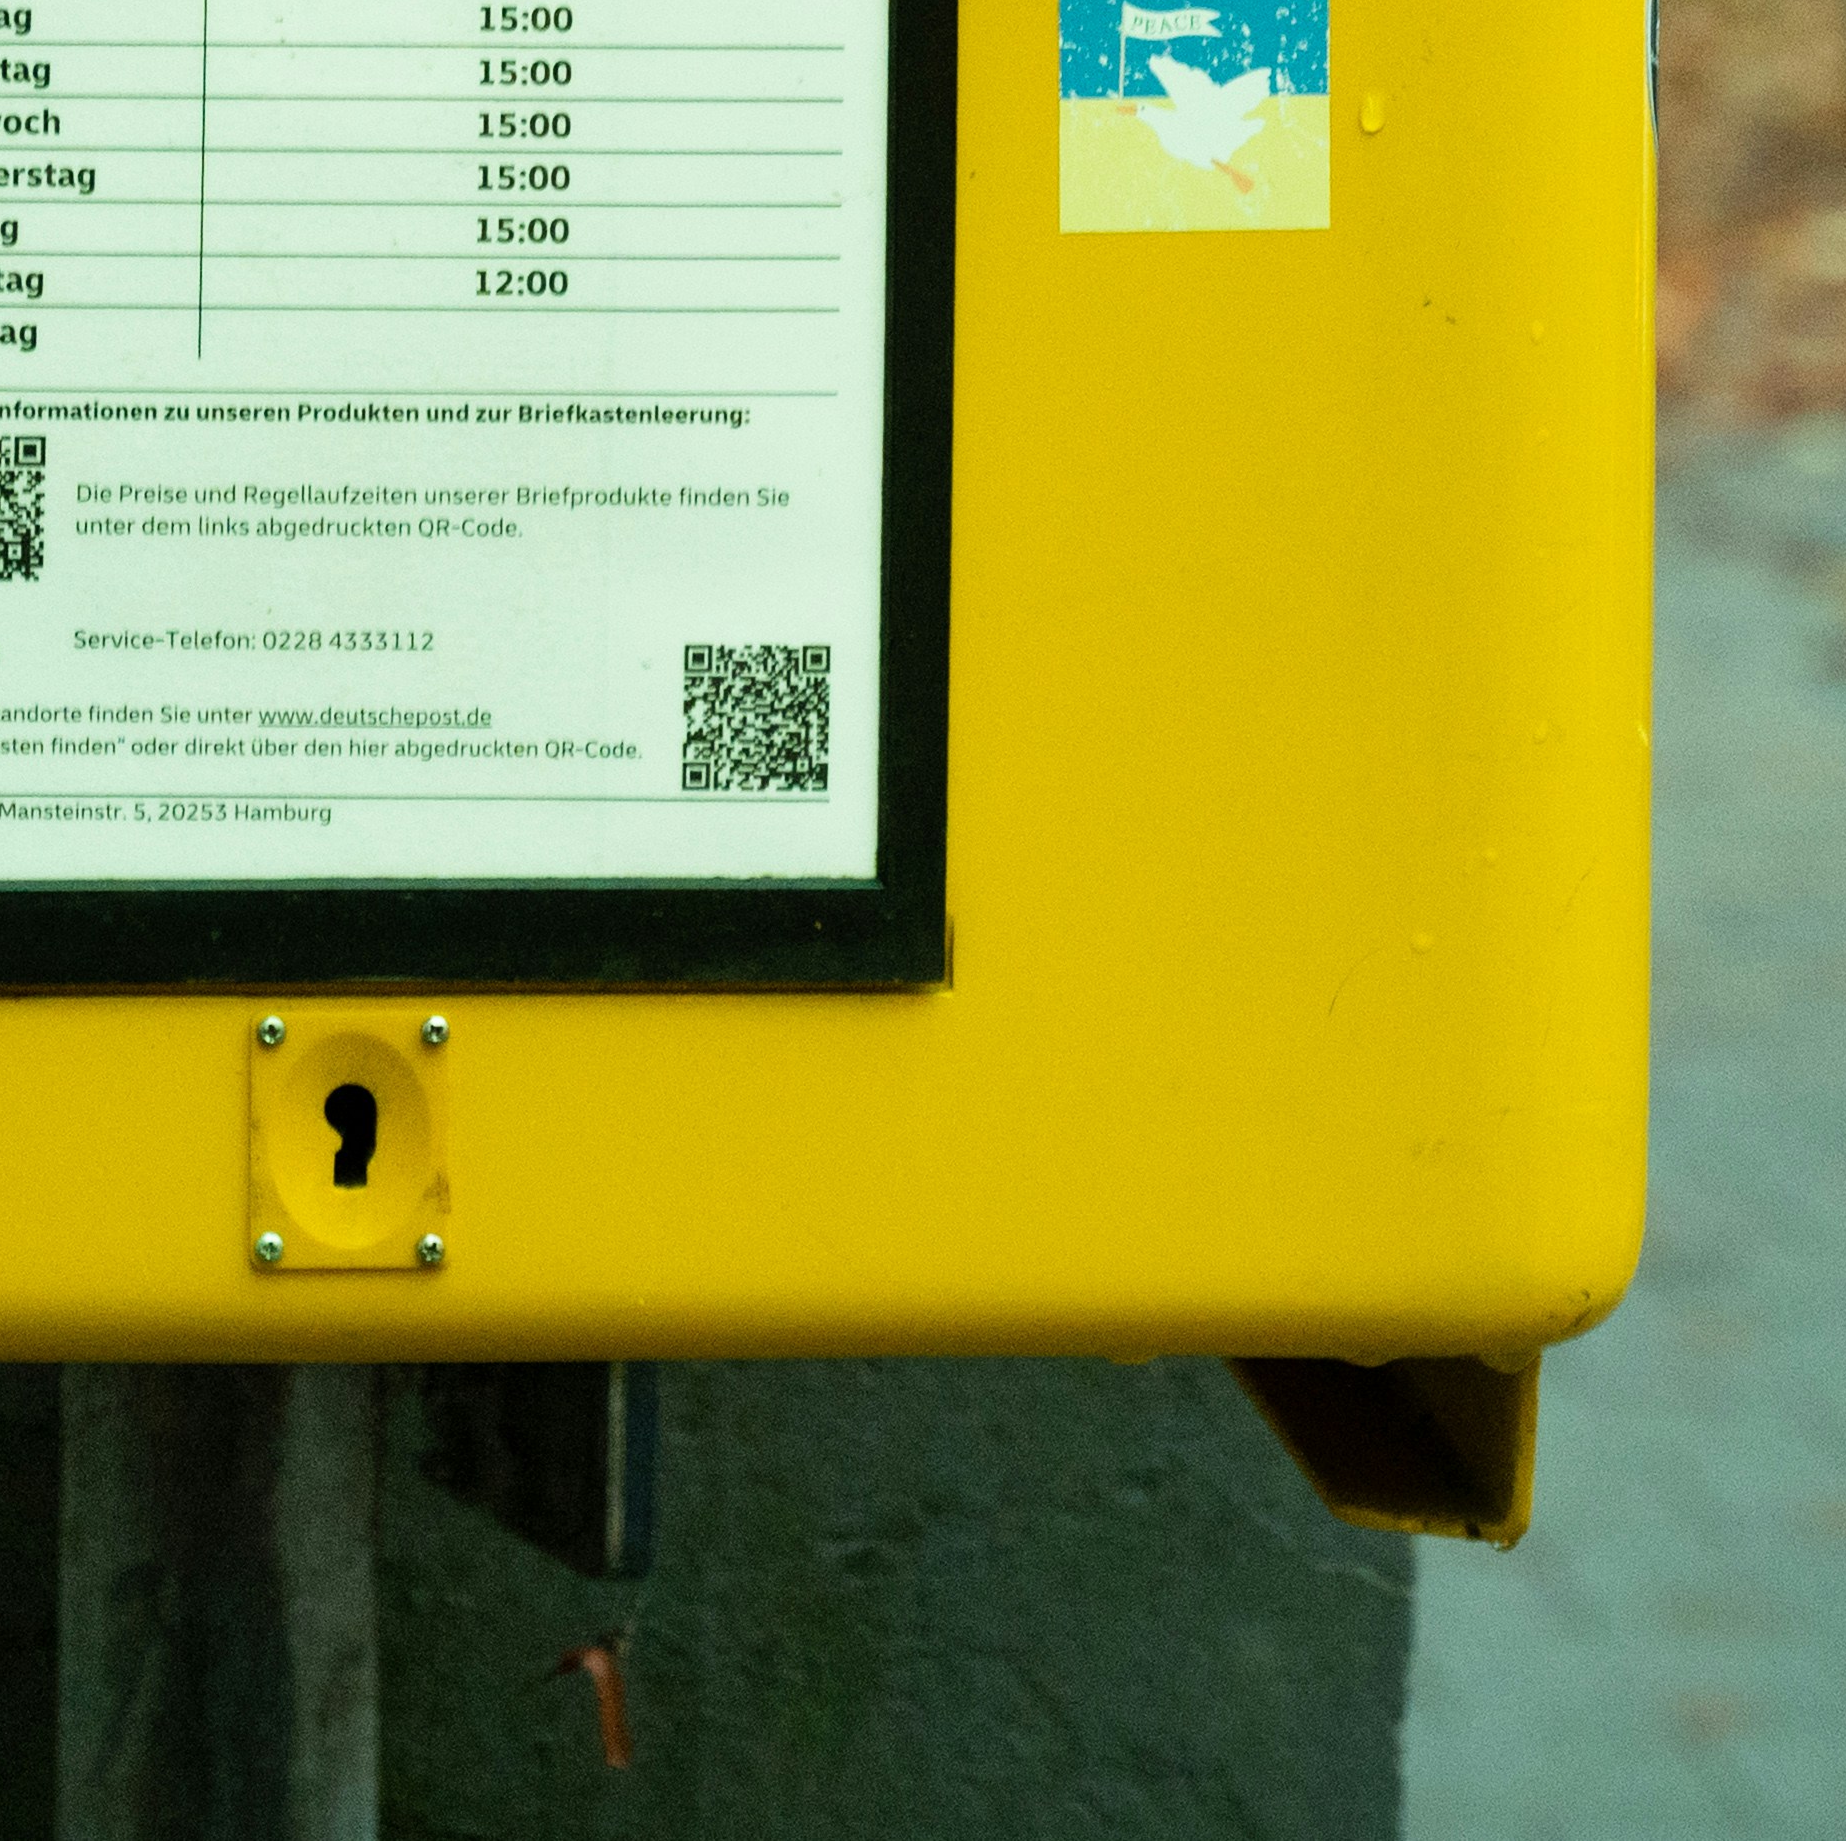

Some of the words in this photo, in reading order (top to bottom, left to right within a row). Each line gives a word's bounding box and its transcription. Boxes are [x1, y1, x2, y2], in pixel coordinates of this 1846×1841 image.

[480, 6, 573, 33] 15:00
[1131, 14, 1201, 34] PEACE
[480, 59, 572, 86] 15:00
[479, 112, 571, 138] 15:00
[478, 164, 571, 191] 15:00
[477, 217, 570, 244] 15:00
[476, 270, 569, 296] 12:00
[164, 406, 190, 421] zu
[196, 406, 290, 422] unseren
[297, 402, 419, 422] Produkten
[426, 403, 469, 422] und
[476, 408, 512, 423] zur
[518, 404, 750, 429] Briefkastenleerung:
[76, 483, 112, 504] Die
[119, 483, 188, 504] Preise
[194, 484, 236, 504] und
[243, 484, 417, 509] Regellaufzeiten
[424, 490, 509, 506] unserer
[516, 485, 672, 510] Briefprodukte
[679, 486, 750, 507] finden
[757, 487, 790, 507] Sie
[75, 517, 135, 536] unter
[141, 516, 191, 536] dem
[198, 515, 250, 536] links
[256, 516, 411, 541] abgedruckten
[418, 517, 522, 539] QR-Code.
[74, 629, 255, 650] Service-Telefon:
[262, 630, 322, 651] 0228
[329, 631, 434, 651] 4333112
[88, 704, 154, 723] finden
[160, 705, 191, 724] Sie
[197, 707, 252, 724] unter
[258, 706, 492, 730] www.deutschepost.de
[131, 737, 178, 756] oder
[184, 737, 245, 756] direkt
[251, 738, 298, 756] über
[304, 738, 342, 757] den
[349, 738, 388, 757] hier
[394, 739, 538, 762] abgedruckten
[544, 739, 642, 760] QR-Code.
[134, 802, 152, 823] 5,
[158, 802, 227, 821] 20253
[234, 802, 332, 826] Hamburg
